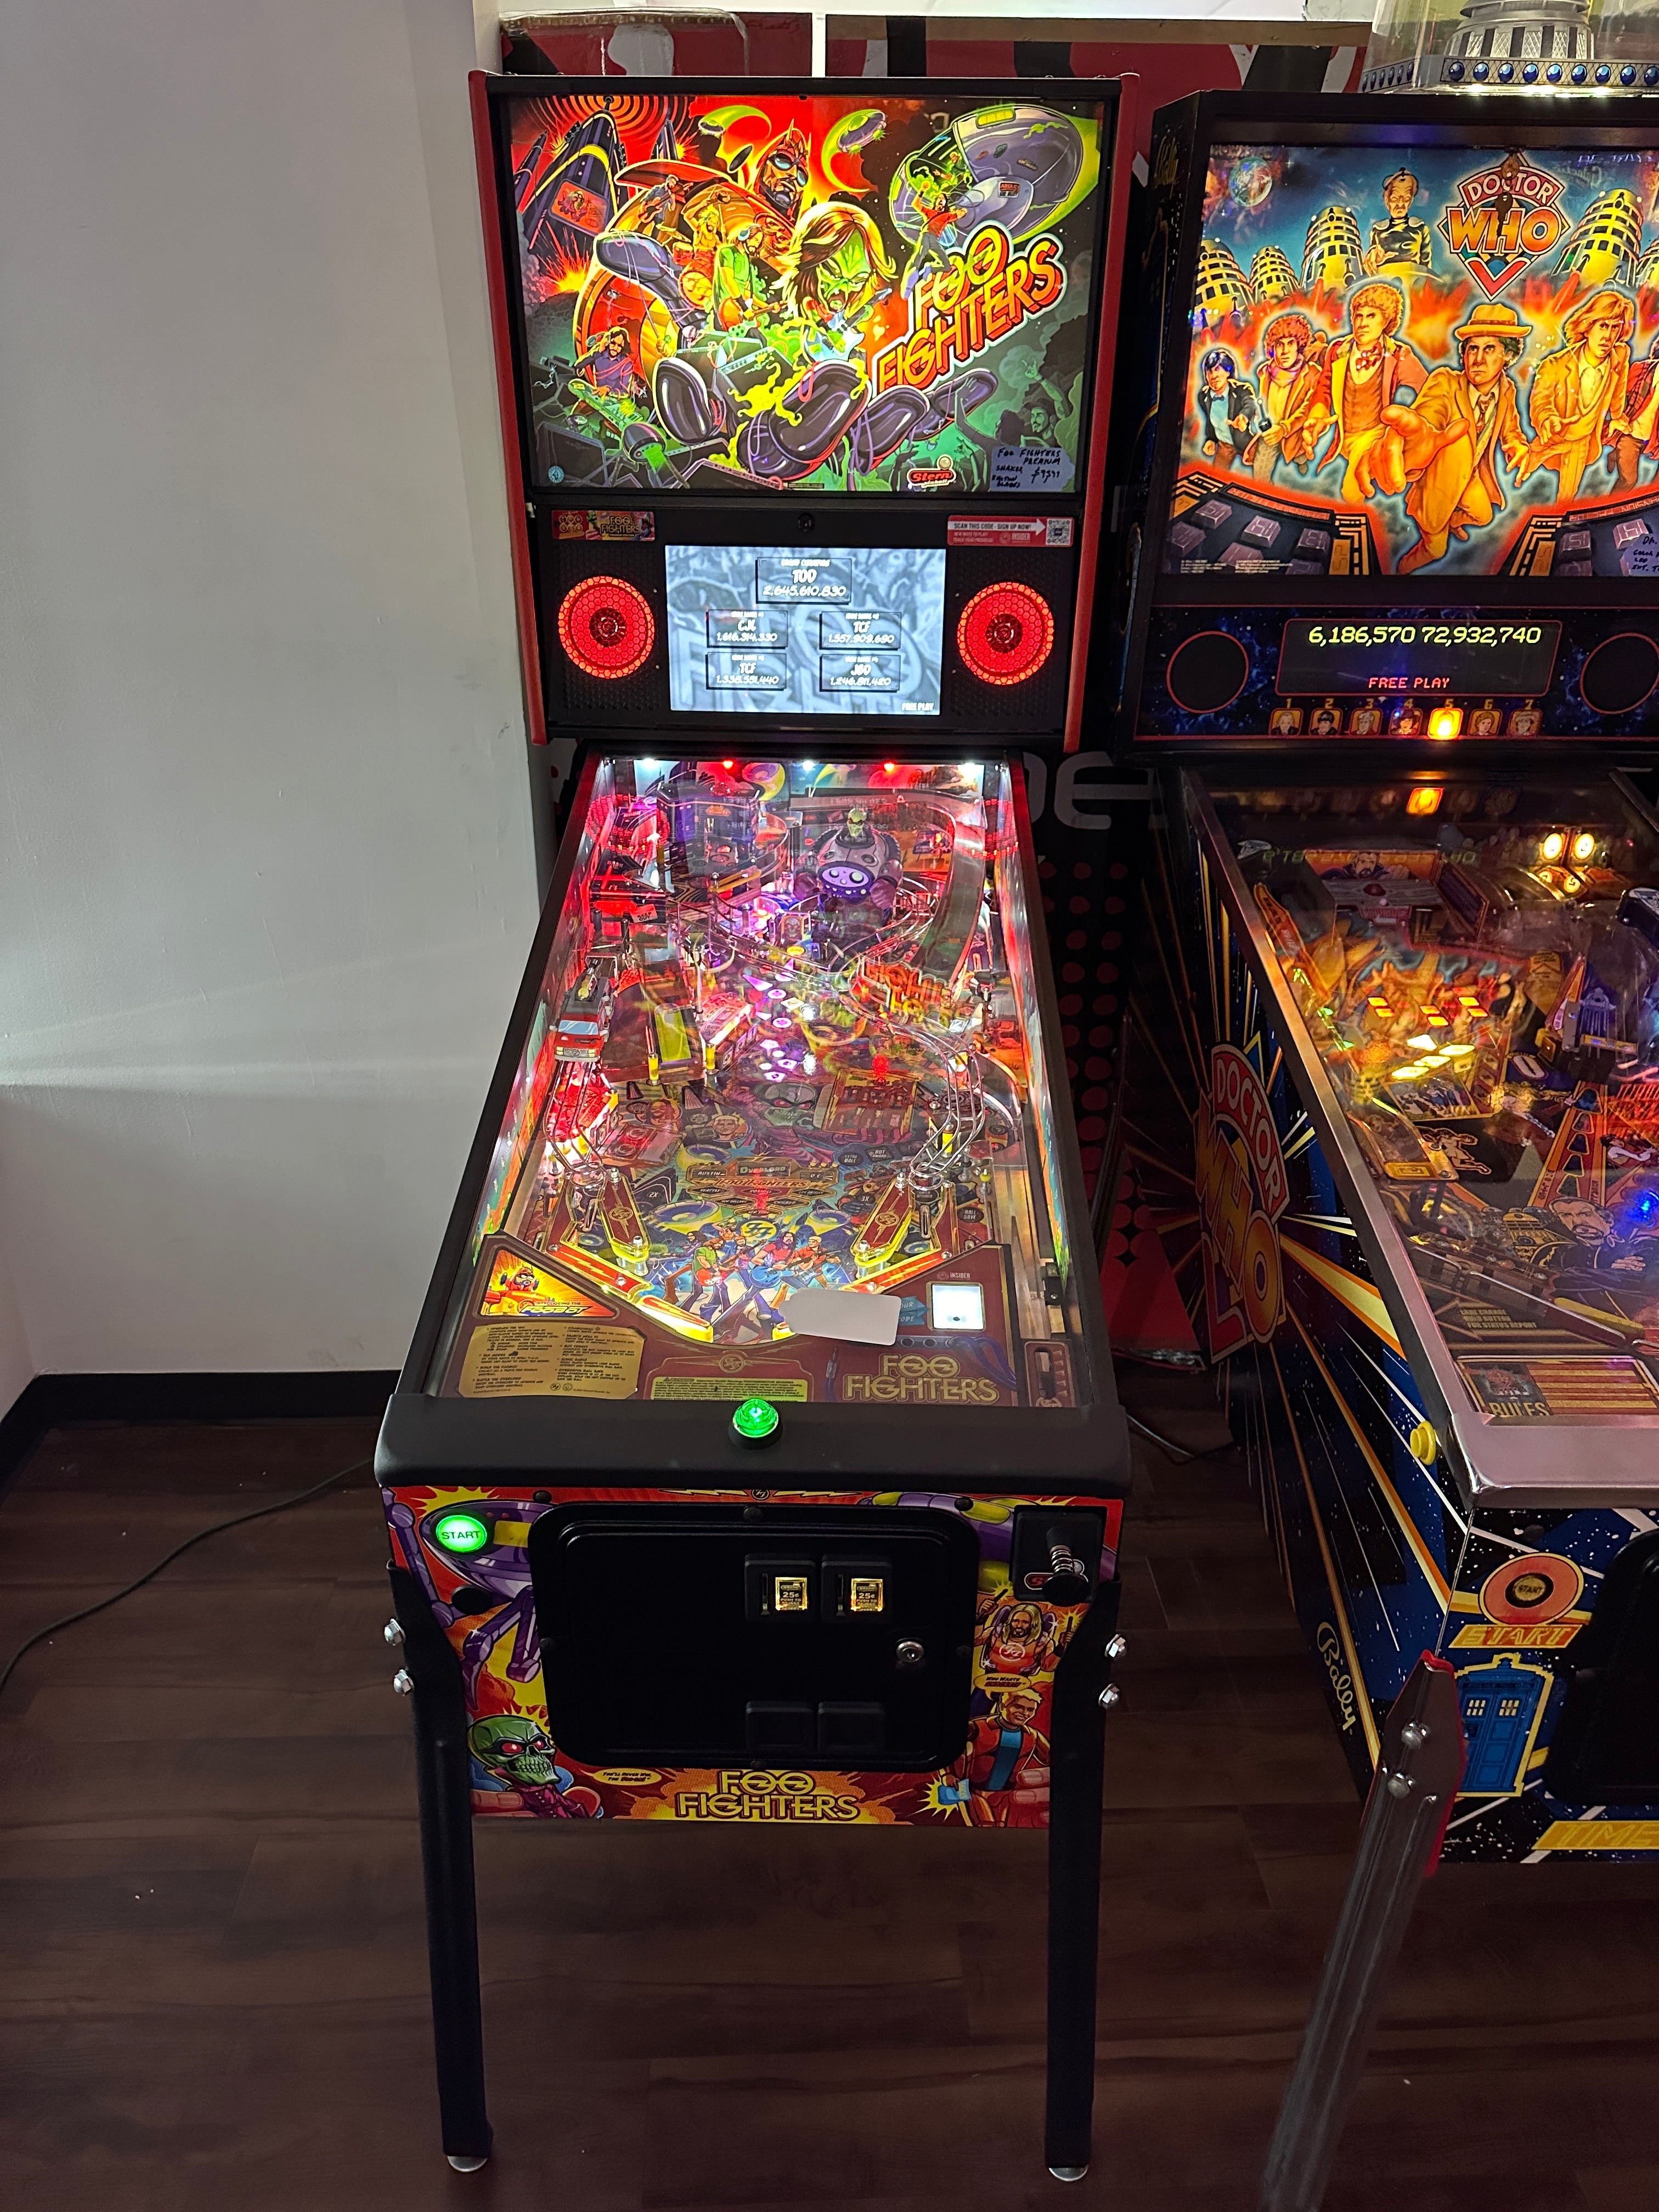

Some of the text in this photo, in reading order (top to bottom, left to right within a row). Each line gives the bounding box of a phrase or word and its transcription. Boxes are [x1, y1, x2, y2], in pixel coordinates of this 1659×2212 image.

[1467, 172, 1554, 204] DOCTOR
[1447, 206, 1561, 255] WHO
[915, 228, 1008, 330] FOO
[879, 241, 1063, 393] FIGHTERS
[1020, 449, 1060, 458] FIGHTERS
[1023, 457, 1060, 465] PREMIUM
[913, 471, 950, 482] Stern
[601, 524, 641, 534] FIGHTERS
[611, 517, 630, 525] FOO
[1308, 627, 1542, 647] 6,186,570 72,932,740
[1369, 677, 1450, 689] FREE PLAY
[1285, 698, 1534, 708] 1 2 3 4 5 6 7
[1215, 1058, 1281, 1209] DOCTOR
[1196, 1089, 1280, 1344] WHO
[883, 1355, 957, 1378] FOO
[847, 1375, 998, 1401] FIGHTERS
[442, 1531, 481, 1539] START
[1518, 1584, 1542, 1594] START
[1462, 1627, 1572, 1645] START
[1317, 1622, 1356, 1730] Bally
[721, 1771, 814, 1795] FOO
[679, 1793, 858, 1819] FIGHTERS
